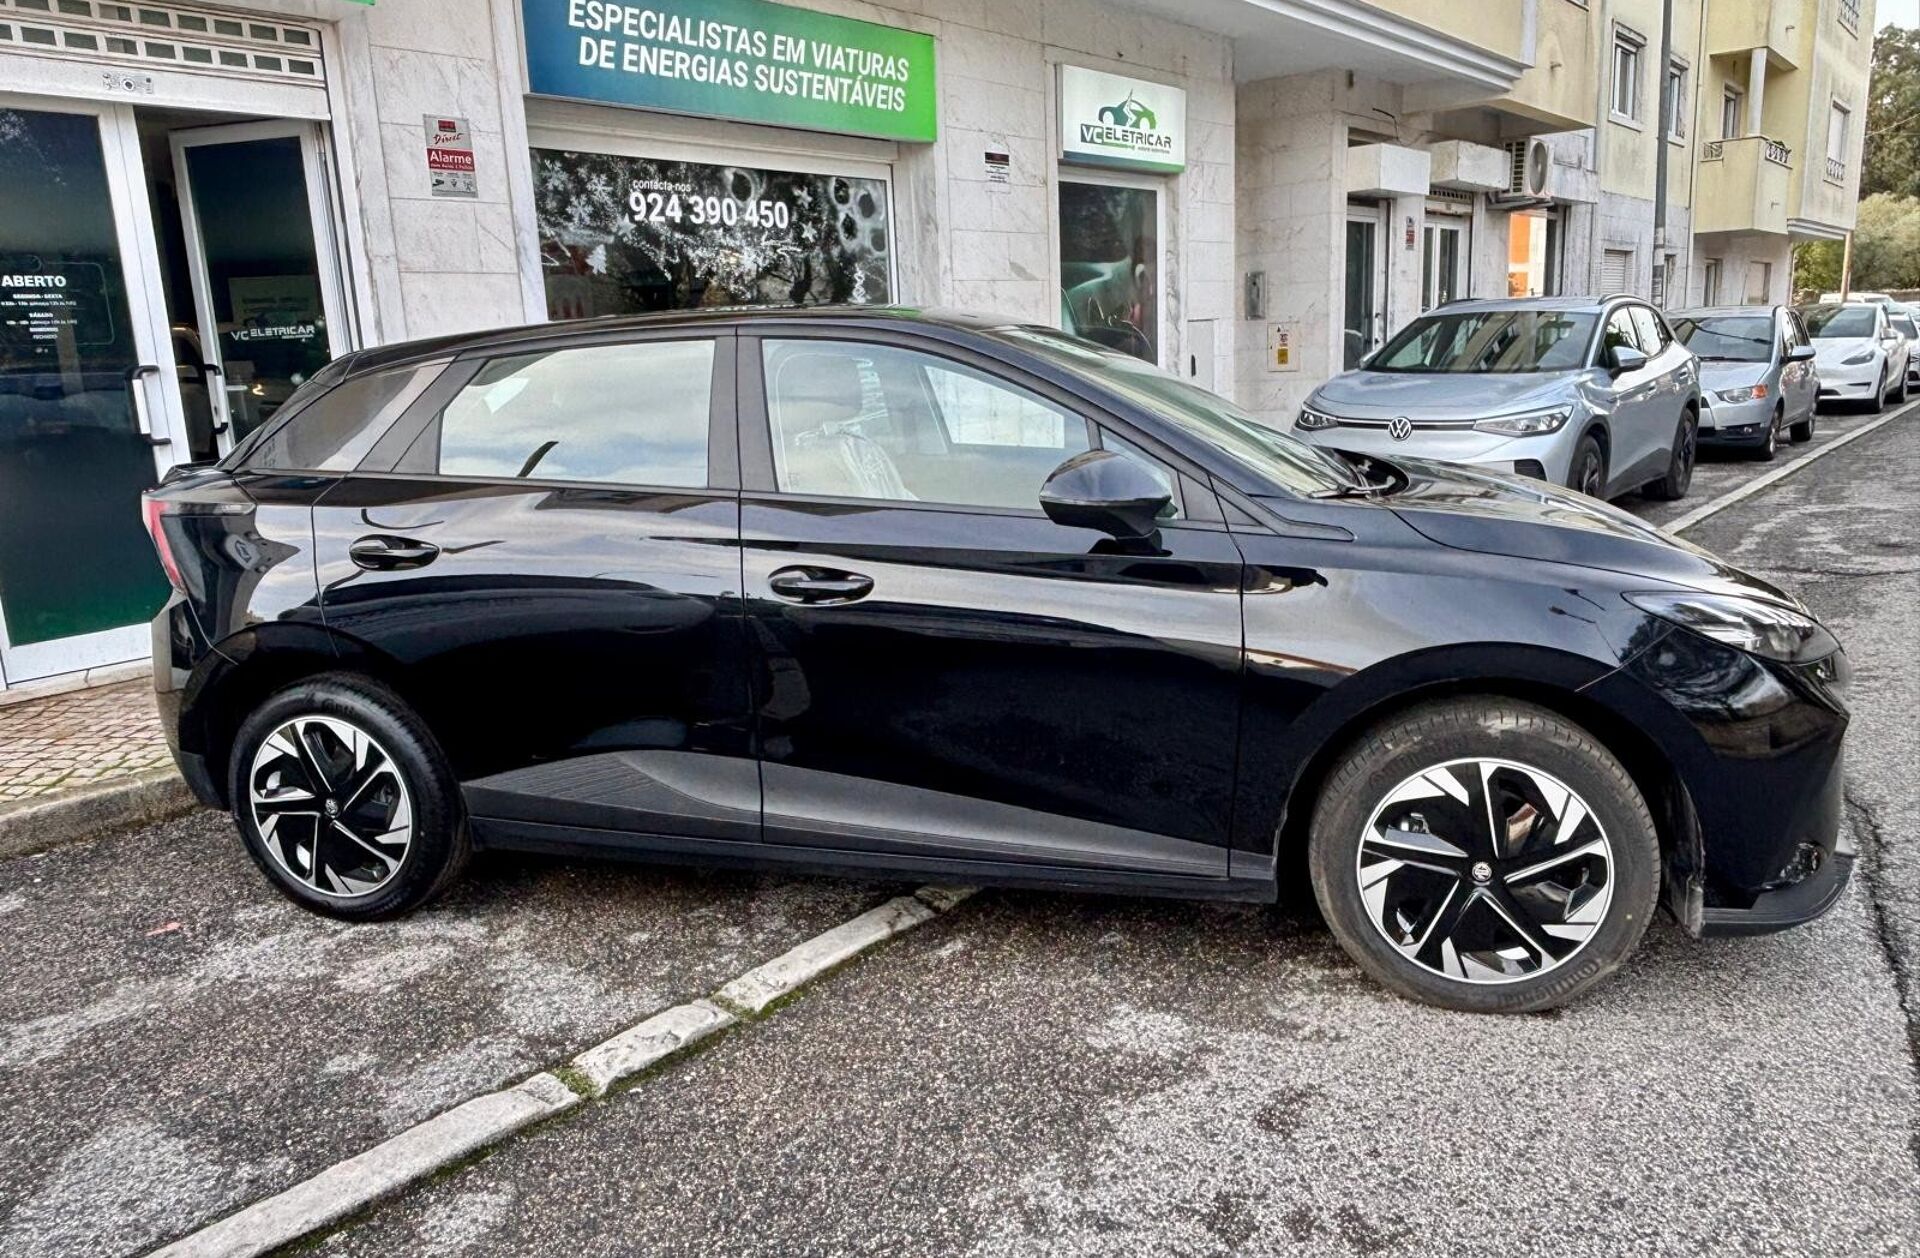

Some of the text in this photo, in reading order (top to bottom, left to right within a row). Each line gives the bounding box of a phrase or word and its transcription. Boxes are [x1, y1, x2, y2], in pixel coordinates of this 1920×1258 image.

[568, 0, 910, 83] ESPECIALISTAS EM VIATURAS
[579, 36, 906, 112] DE ENERGIAS SUSTENTÁVEIS
[430, 150, 473, 165] Alarme
[629, 191, 789, 229] 924 390 450
[1, 275, 67, 288] ABERTO
